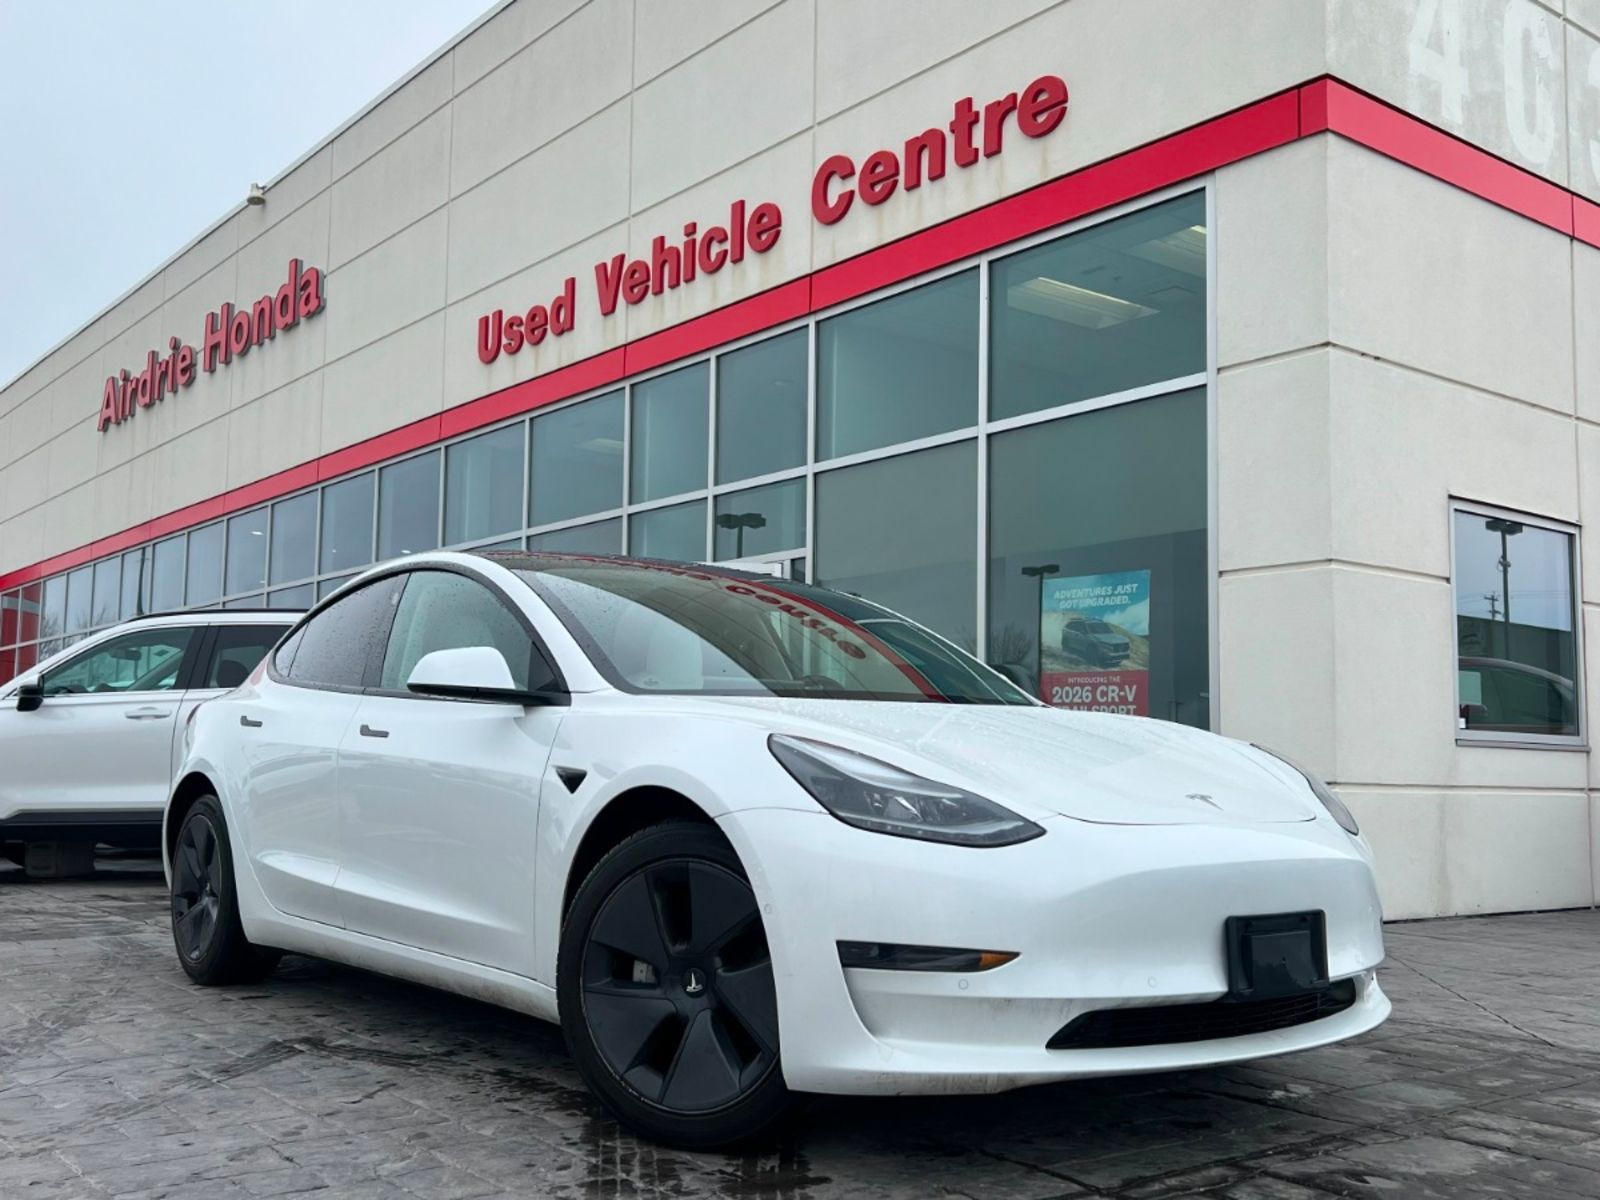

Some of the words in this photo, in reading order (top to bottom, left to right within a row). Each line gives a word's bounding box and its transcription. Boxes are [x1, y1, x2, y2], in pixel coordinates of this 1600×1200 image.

[478, 276, 577, 365] Used
[594, 199, 783, 317] Vehicle
[812, 74, 1069, 225] Centre
[97, 336, 197, 432] Airdrie
[203, 257, 326, 373] Honda
[1054, 586, 1113, 599] ADVENTURES
[1113, 583, 1139, 595] JUST
[1059, 599, 1078, 609] GOT
[1080, 595, 1131, 608] UPGRADED.
[1068, 676, 1107, 684] INTRODUCING
[1109, 675, 1120, 683] THE
[1052, 685, 1093, 703] 2026
[1096, 684, 1137, 703] CR-V
